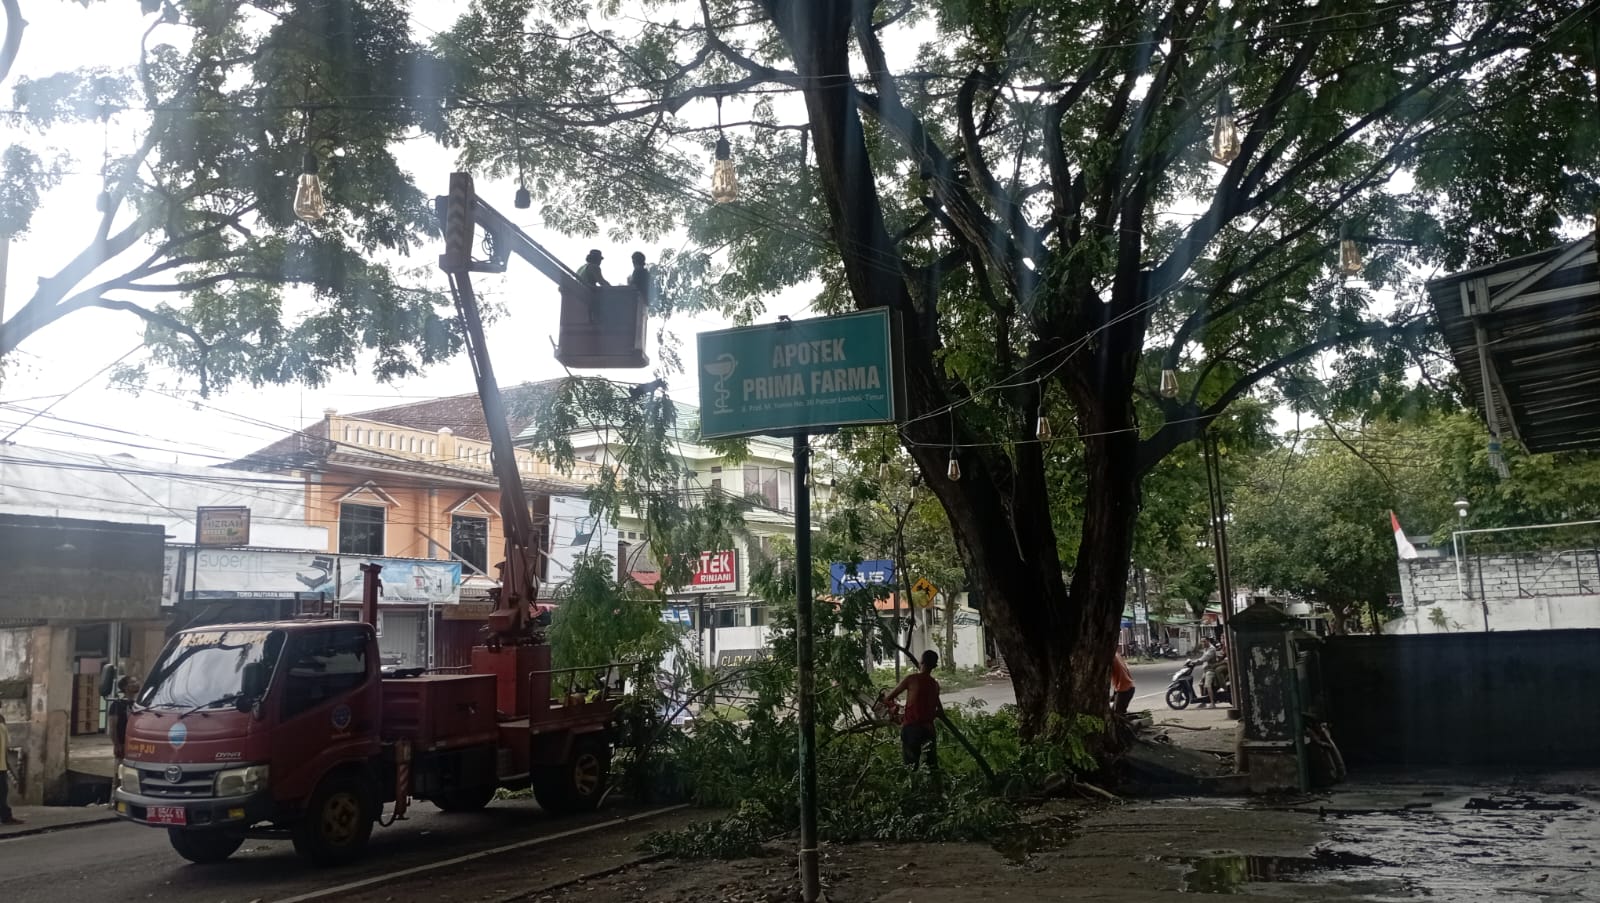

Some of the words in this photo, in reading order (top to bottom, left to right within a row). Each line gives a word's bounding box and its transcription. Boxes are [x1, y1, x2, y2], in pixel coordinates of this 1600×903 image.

[773, 338, 846, 368] APOTEK
[743, 373, 805, 401] PRIMA
[811, 366, 880, 394] FARMA
[700, 573, 731, 583] RINJANI
